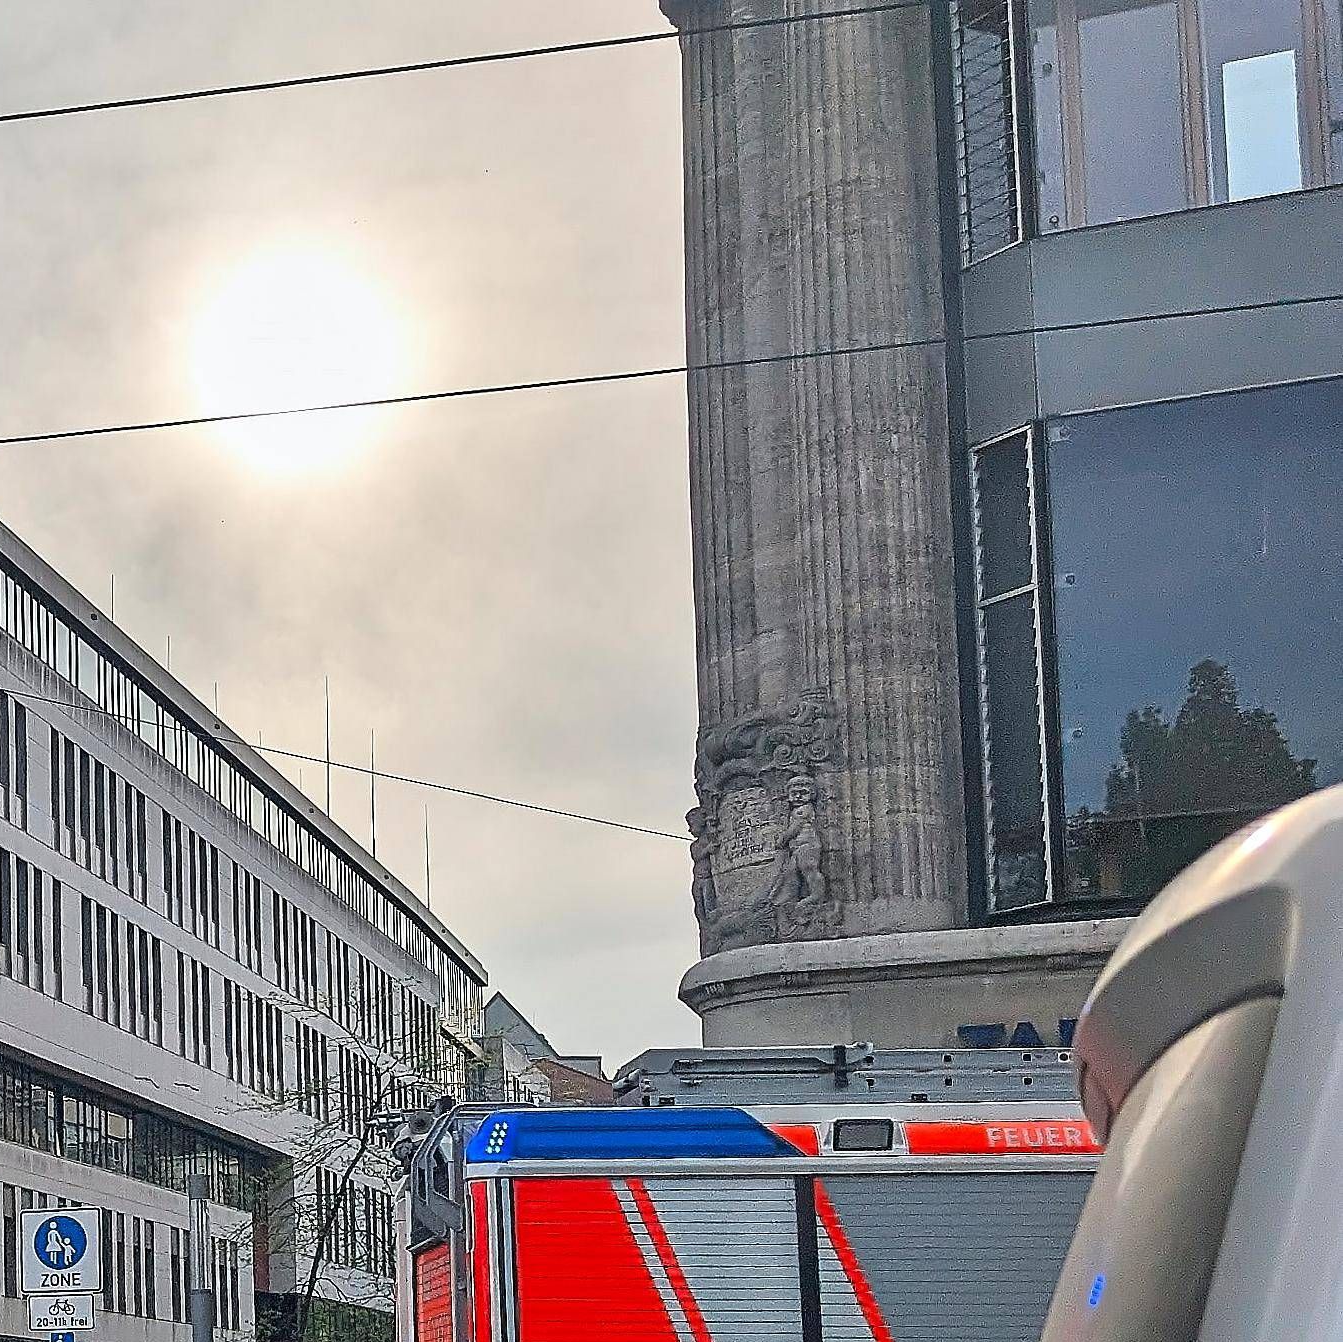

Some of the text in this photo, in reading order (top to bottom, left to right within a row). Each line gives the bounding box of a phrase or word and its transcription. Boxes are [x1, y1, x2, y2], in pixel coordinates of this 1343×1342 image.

[986, 1126, 1100, 1148] FEUER
[40, 1272, 82, 1288] ZONE
[36, 1317, 88, 1328] 20-11h frei
